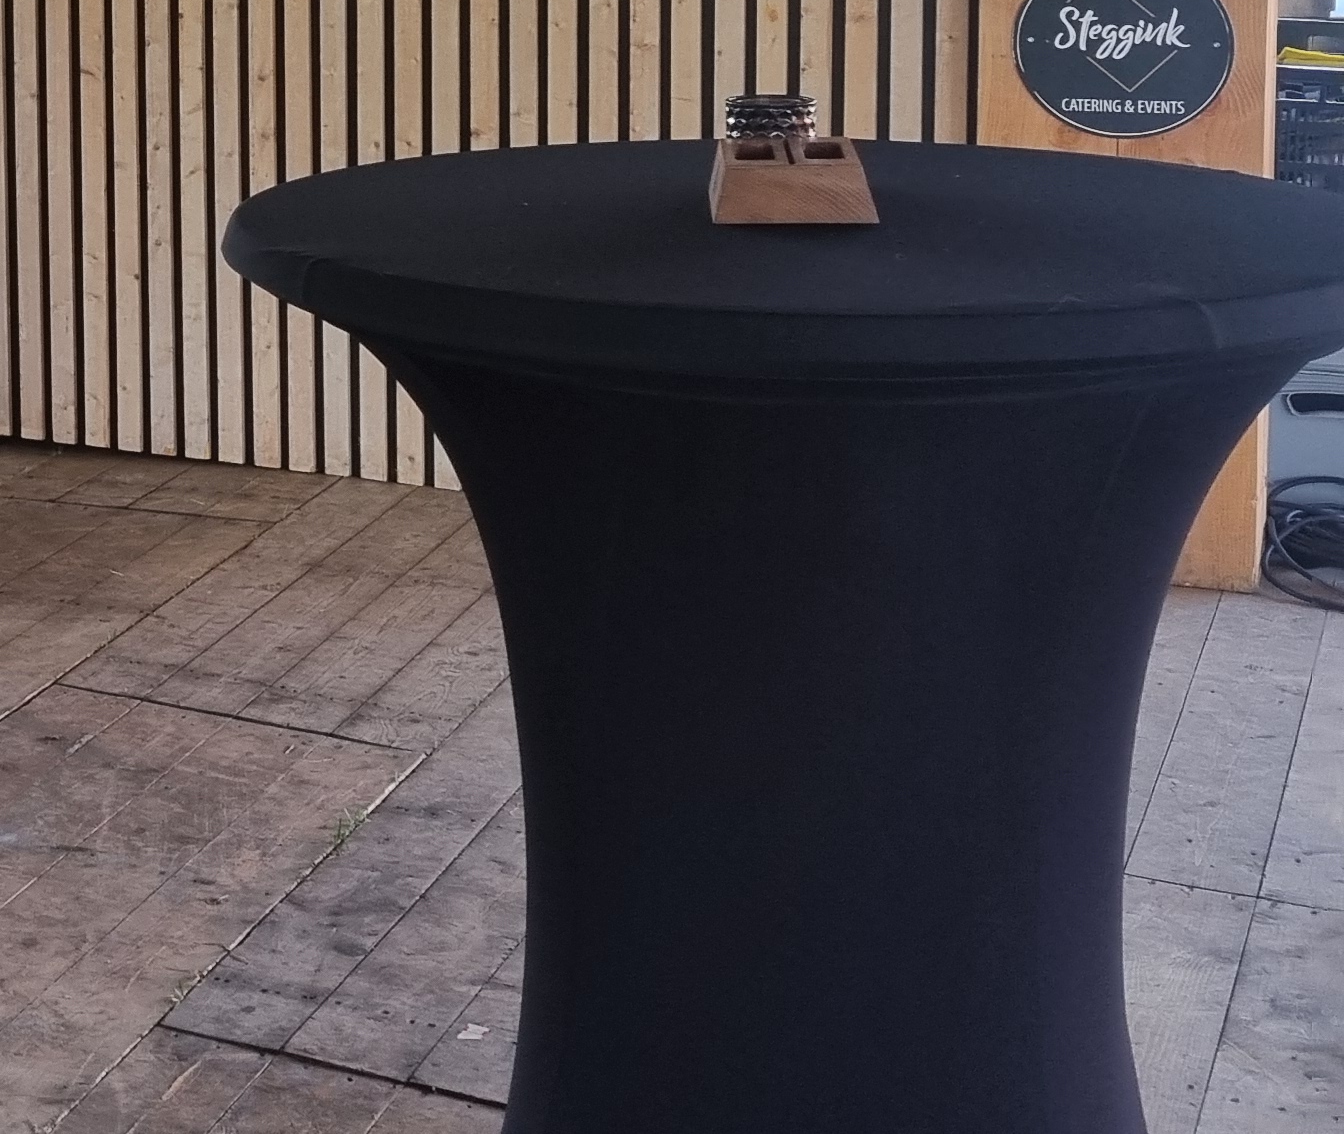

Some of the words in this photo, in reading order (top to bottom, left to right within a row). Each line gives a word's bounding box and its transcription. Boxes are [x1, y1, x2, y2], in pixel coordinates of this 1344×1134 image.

[1053, 6, 1192, 60] Steggink
[1061, 97, 1122, 113] CATERING
[1124, 99, 1135, 114] &
[1137, 100, 1186, 115] EVENTS
